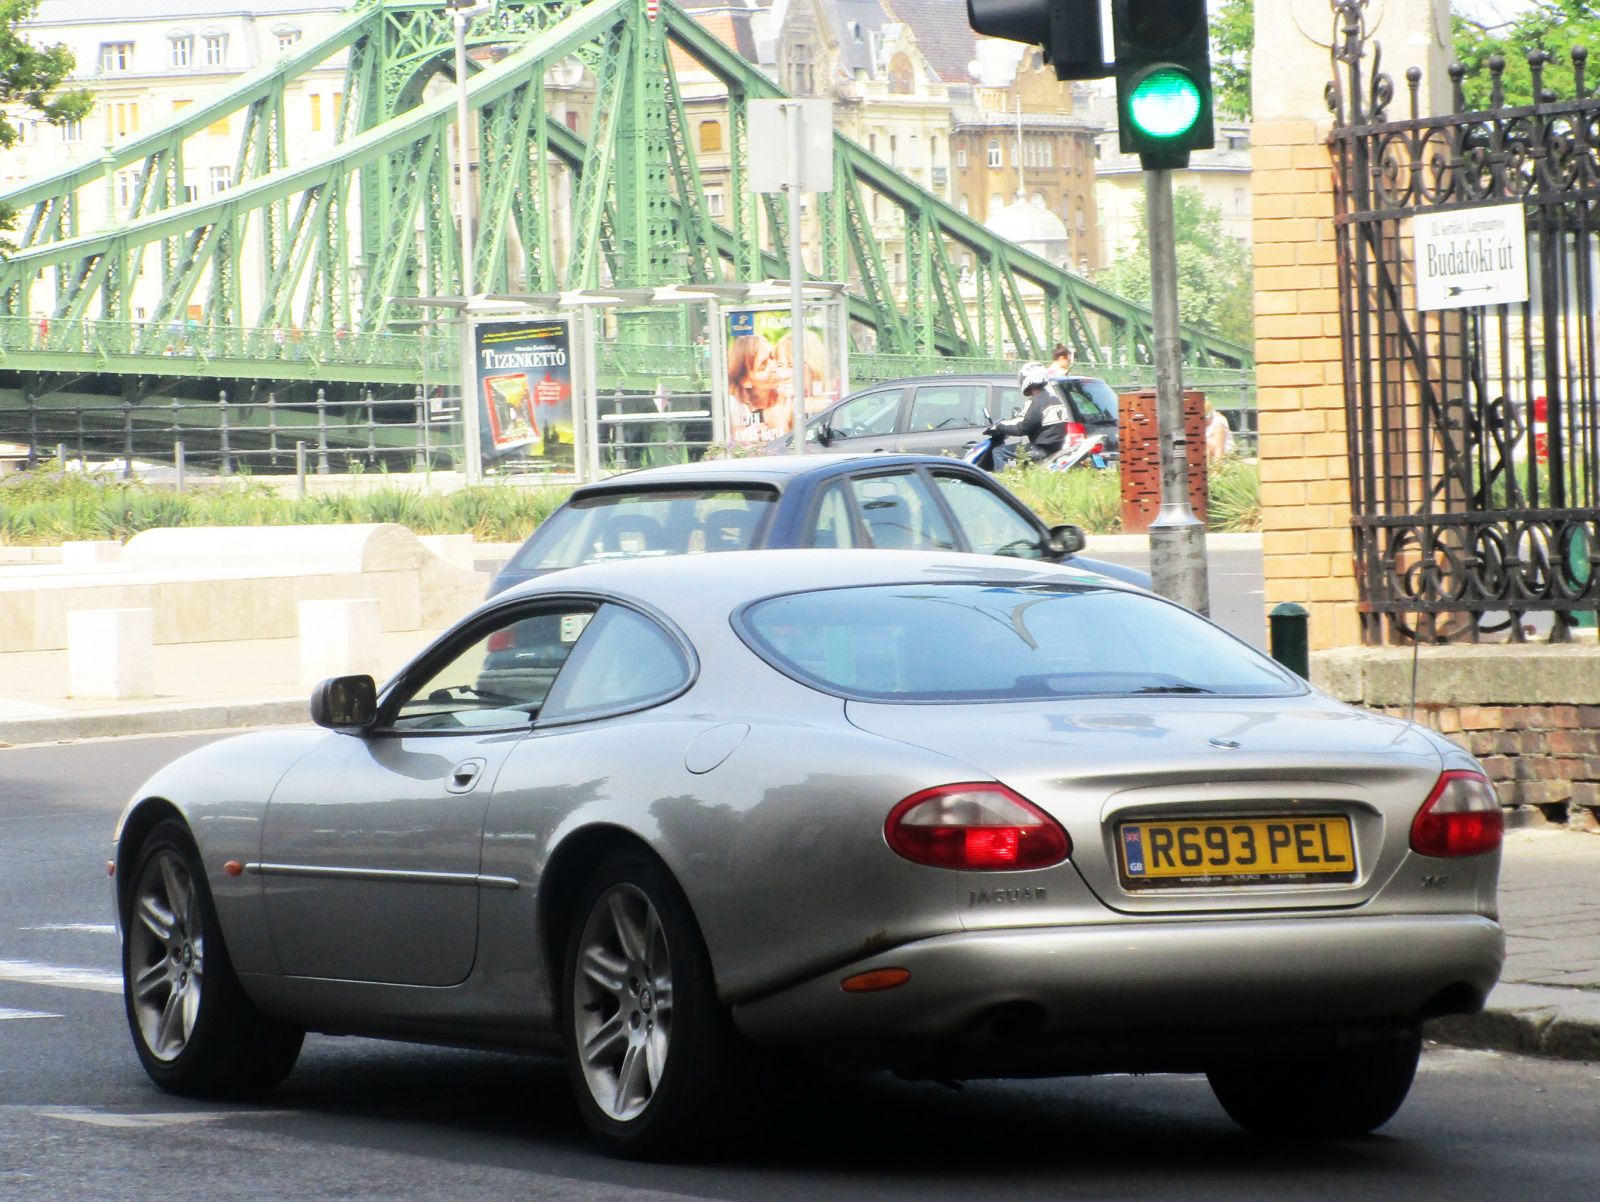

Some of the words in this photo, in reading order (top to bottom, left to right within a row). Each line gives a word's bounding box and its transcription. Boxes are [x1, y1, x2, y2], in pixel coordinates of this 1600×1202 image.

[1426, 237, 1493, 278] Budafoki
[1498, 236, 1514, 270] út
[481, 348, 566, 370] TIZENKETTŐ
[1148, 825, 1257, 868] R693
[1266, 823, 1346, 865] PEL
[1129, 862, 1143, 872] GB
[968, 886, 1046, 908] JAGUAR
